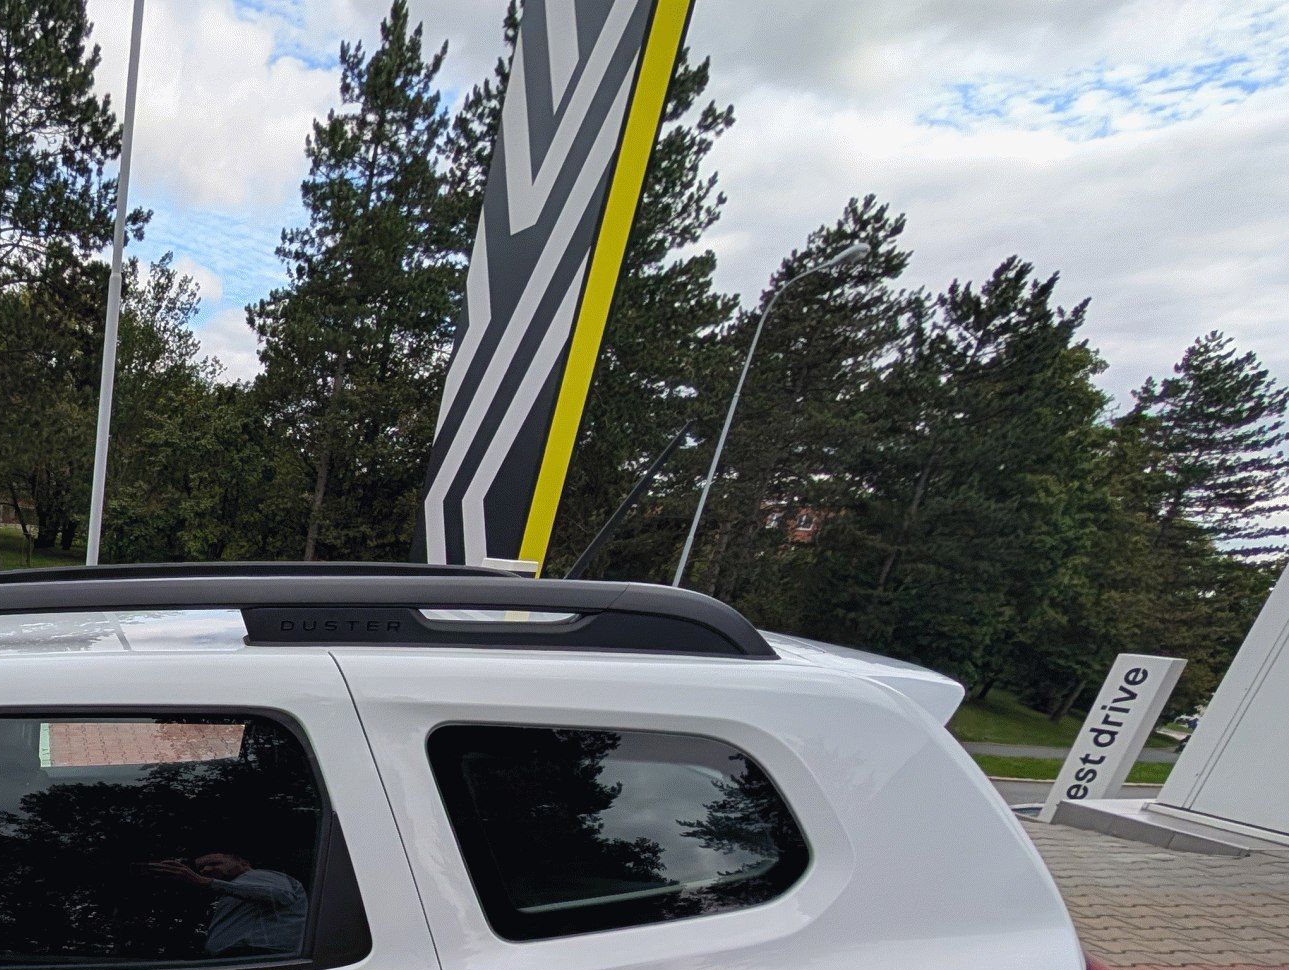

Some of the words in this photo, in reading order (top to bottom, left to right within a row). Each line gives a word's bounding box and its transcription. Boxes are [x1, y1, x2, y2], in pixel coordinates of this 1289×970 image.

[280, 619, 401, 632] DUSTER
[1066, 753, 1107, 800] est
[1089, 667, 1149, 748] drive
